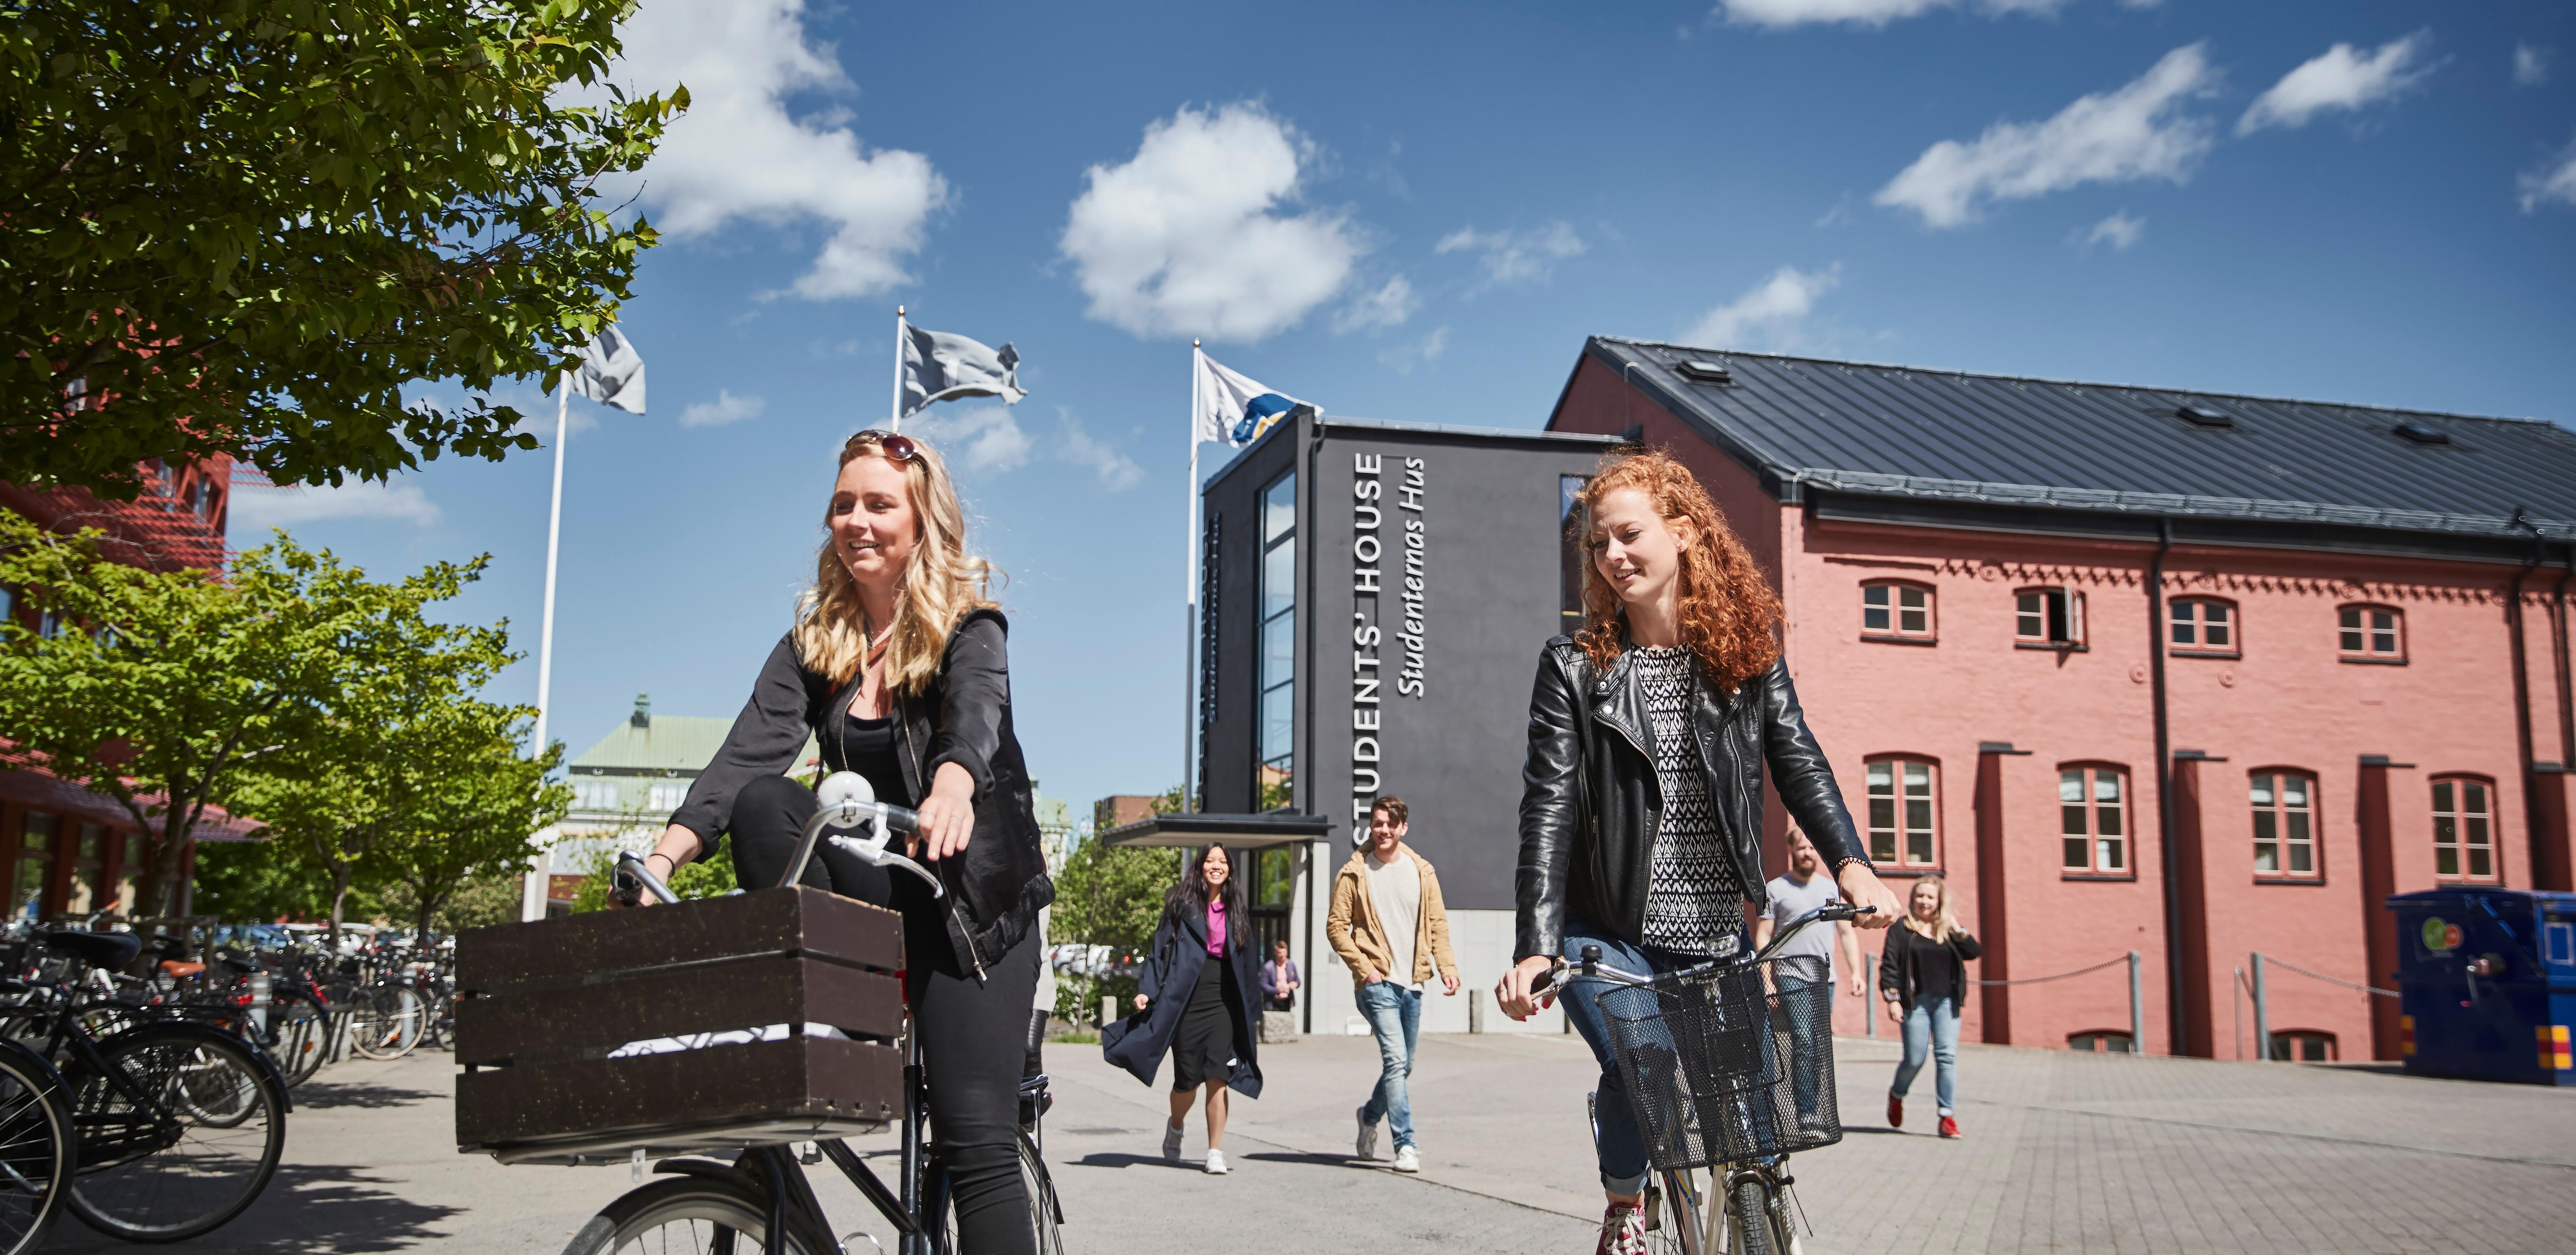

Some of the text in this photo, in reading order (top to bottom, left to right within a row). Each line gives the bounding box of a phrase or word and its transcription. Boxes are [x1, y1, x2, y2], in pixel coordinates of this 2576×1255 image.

[1354, 453, 1381, 592] HOUSE
[1396, 457, 1424, 697] Studenternas Hus
